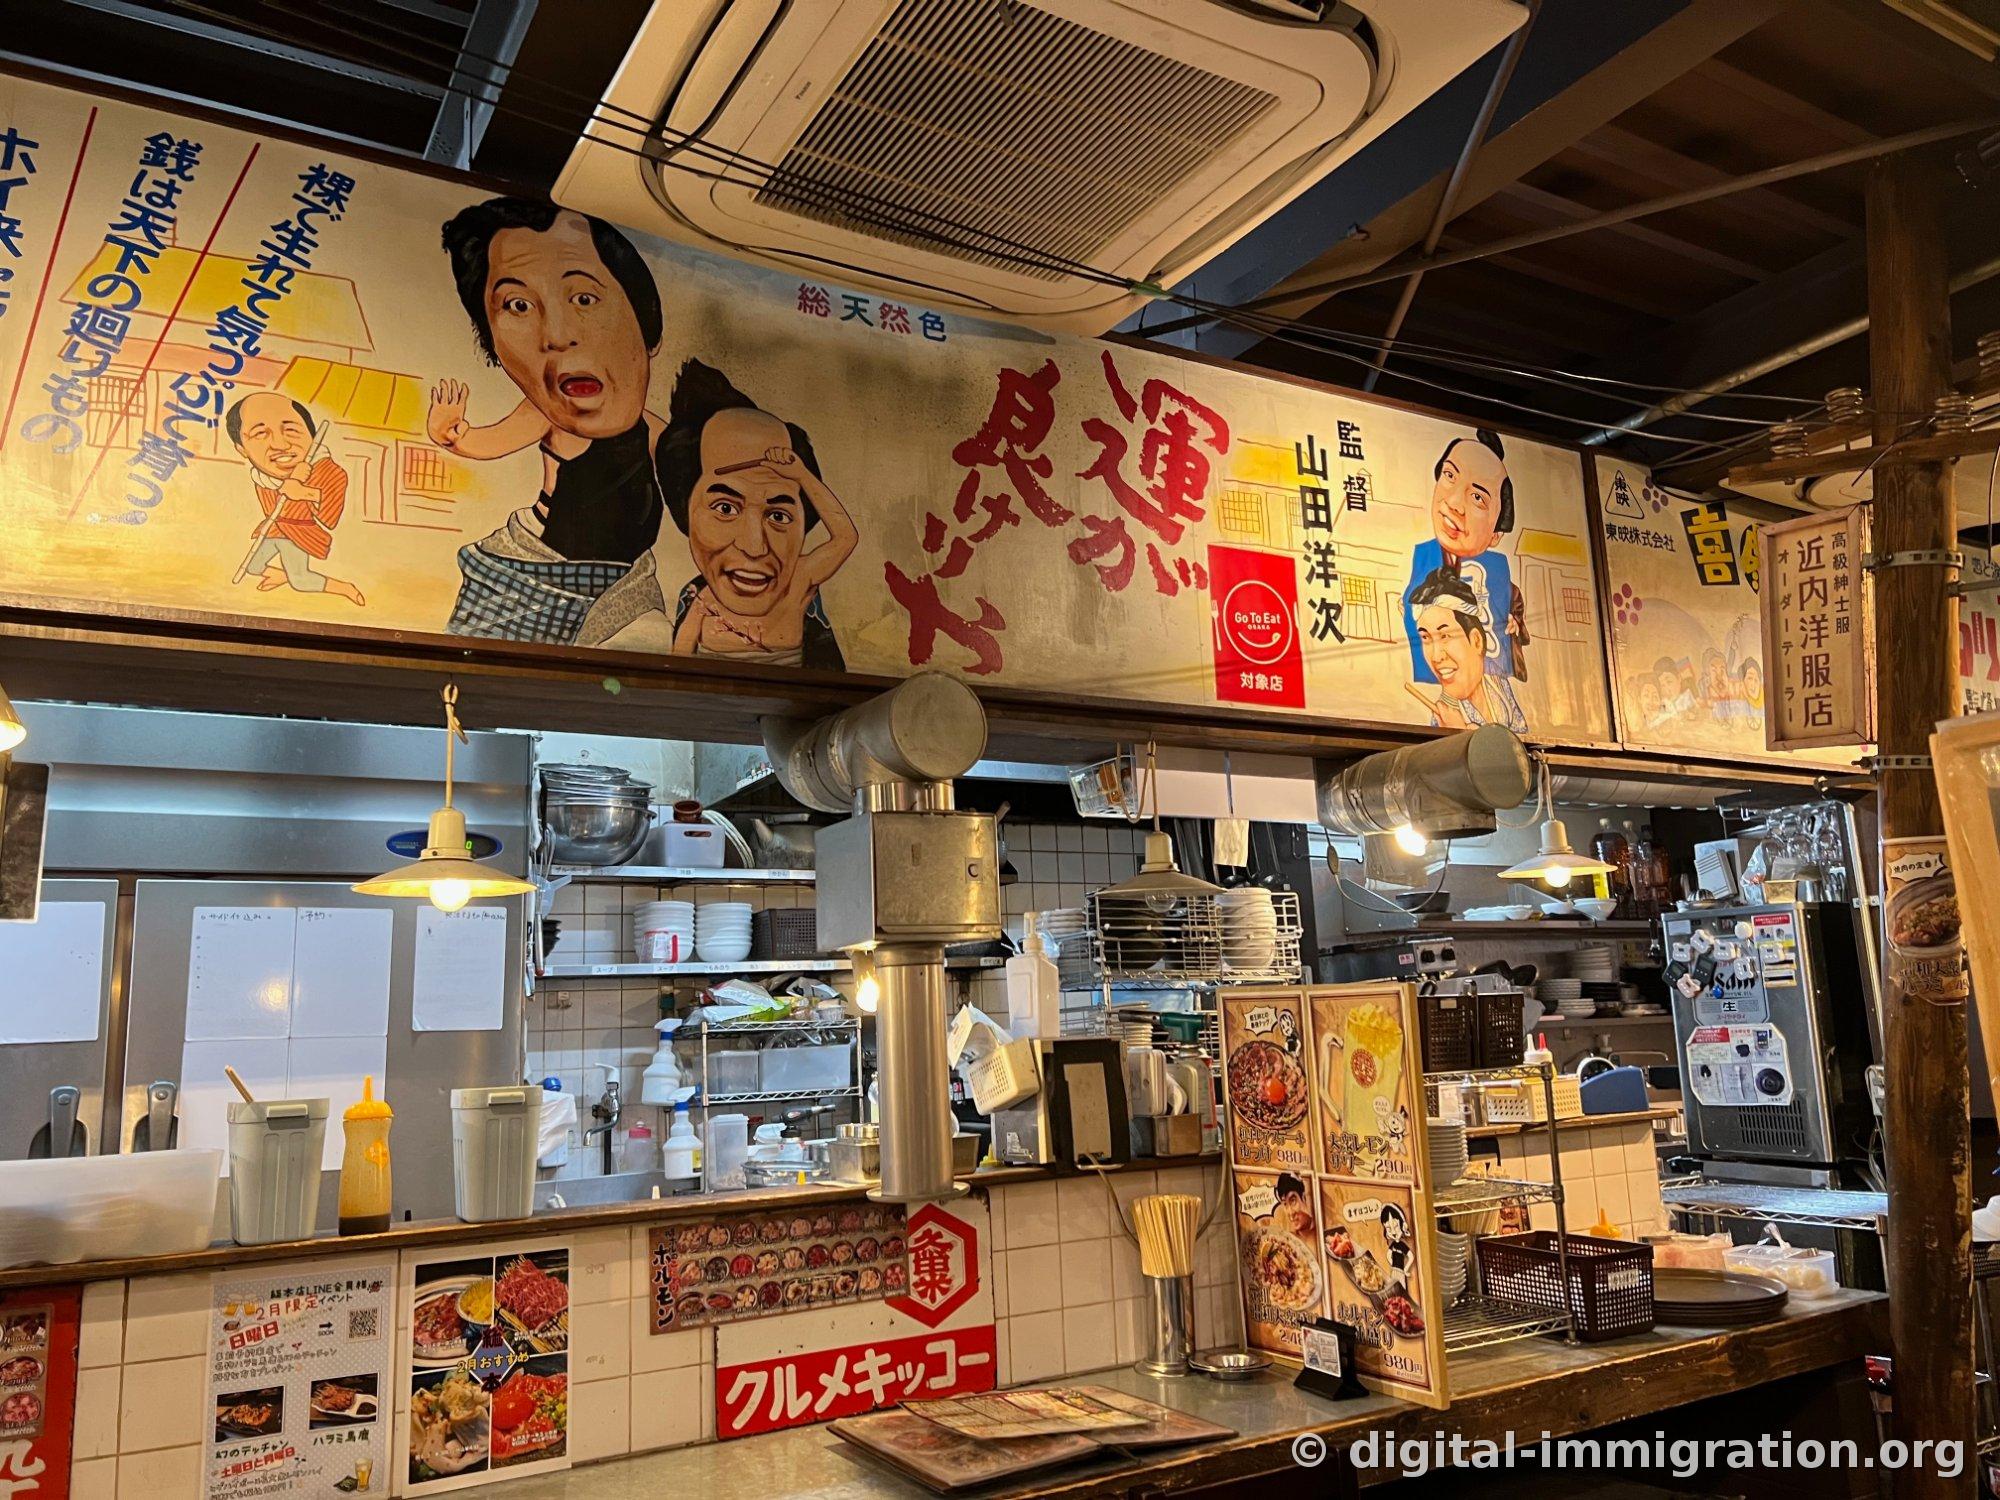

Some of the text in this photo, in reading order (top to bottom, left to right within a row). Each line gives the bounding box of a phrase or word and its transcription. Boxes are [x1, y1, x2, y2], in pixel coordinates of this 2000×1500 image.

[797, 282, 948, 342] 総天然色
[1337, 420, 1368, 512] 監督
[1614, 476, 1631, 508] 東映
[1296, 434, 1346, 644] 山田洋次
[1605, 522, 1676, 552] 東映株式会社
[1831, 531, 1850, 635] 高級紳士服
[1234, 612, 1281, 624] Go To Eat
[1777, 549, 1796, 723] オーダーテーラー
[1796, 535, 1833, 728] 近内洋服店
[1240, 671, 1284, 692] 対象店
[1722, 1001, 1737, 1012] 生
[652, 1243, 675, 1328] ホルモン
[228, 1320, 280, 1350] 日曜日
[457, 1350, 530, 1374] 2月おすすめ
[725, 1338, 991, 1431] クルメキッコー
